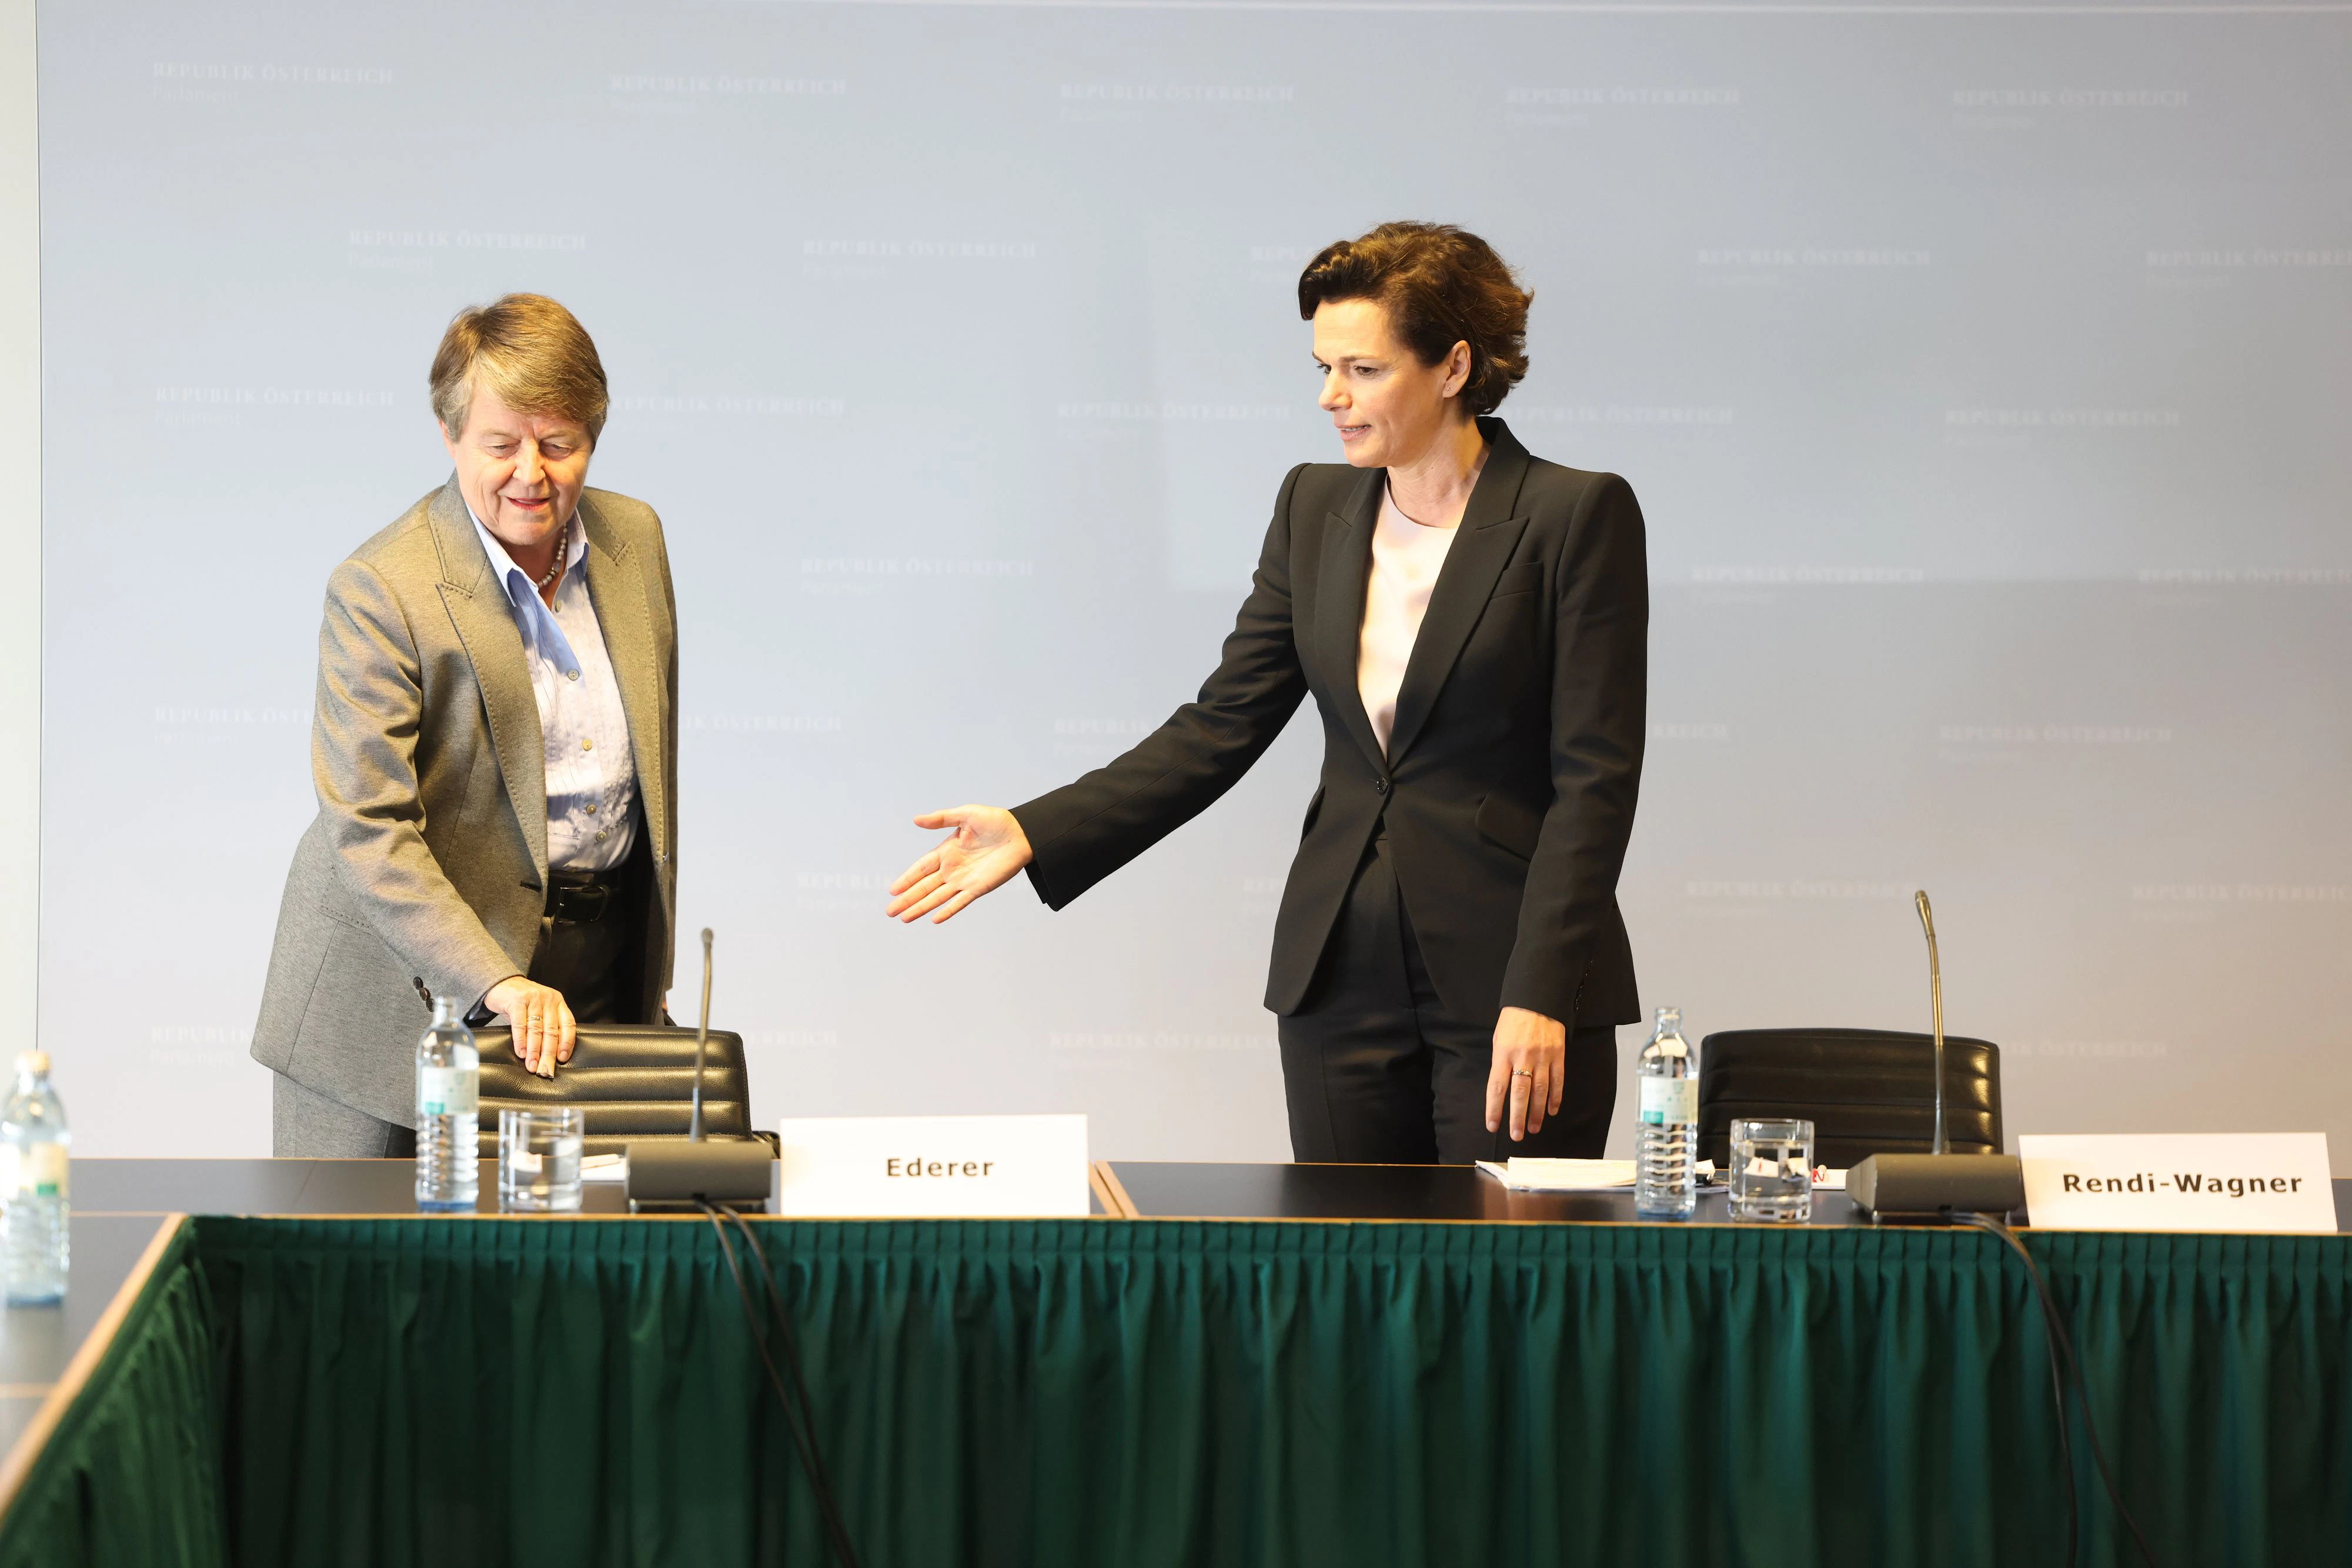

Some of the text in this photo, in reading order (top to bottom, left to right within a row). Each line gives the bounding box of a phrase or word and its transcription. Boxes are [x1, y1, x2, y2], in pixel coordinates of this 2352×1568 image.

[153, 62, 393, 85] REPUBLIK ÖSTERREICH
[349, 229, 587, 250] REPUBLIK ÖSTERREICH
[155, 386, 395, 407] REPUBLIK ÖSTERREICH
[154, 707, 255, 724] REPUBLIK
[887, 1158, 994, 1176] Ederer
[2063, 1173, 2303, 1198] Rendi-Wagner
